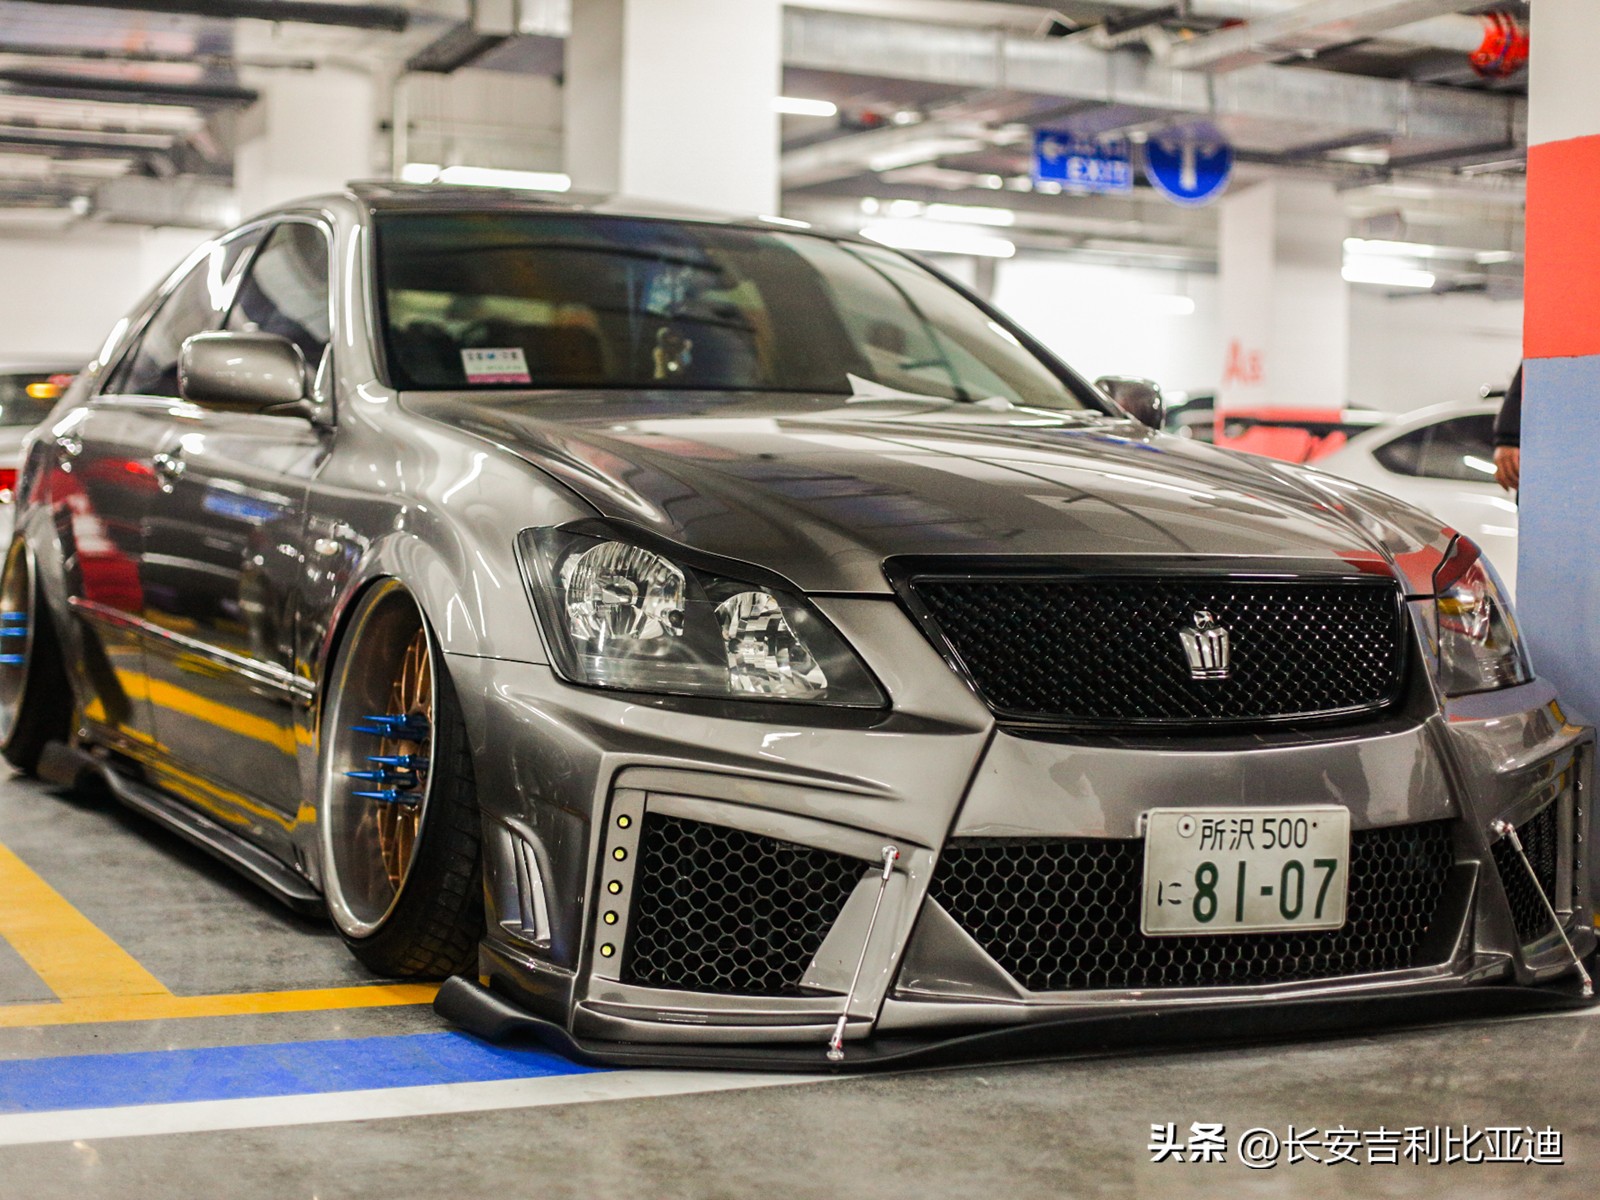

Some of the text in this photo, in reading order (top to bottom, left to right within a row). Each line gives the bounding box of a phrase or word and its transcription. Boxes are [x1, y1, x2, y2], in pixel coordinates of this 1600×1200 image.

[1200, 818, 1308, 850] 所沢 500
[1157, 858, 1338, 923] に 81-07
